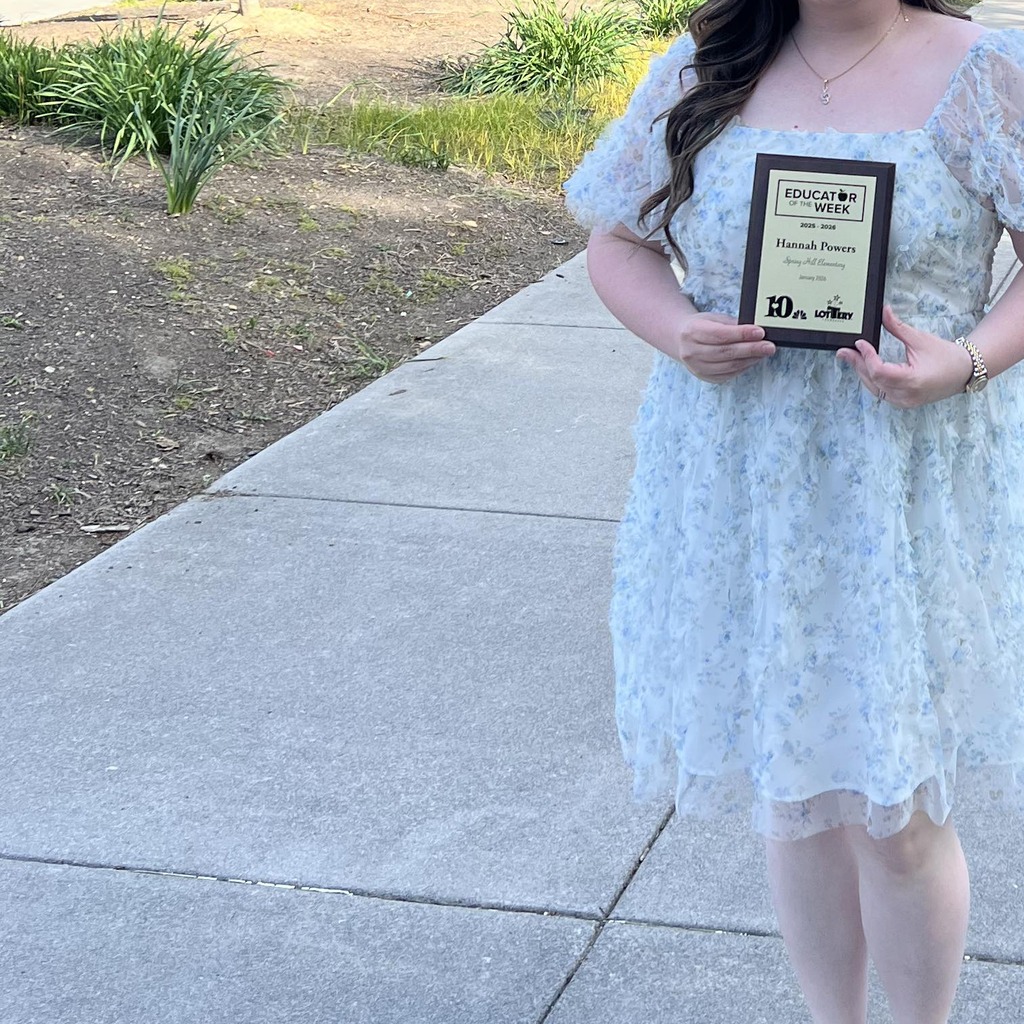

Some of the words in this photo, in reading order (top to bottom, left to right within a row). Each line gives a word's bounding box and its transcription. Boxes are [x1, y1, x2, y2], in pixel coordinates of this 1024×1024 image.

[814, 202, 850, 215] WEEK
[776, 238, 817, 250] Hannah
[821, 242, 856, 253] Powers
[764, 295, 794, 318] 10
[814, 305, 854, 320] LOTTERY
